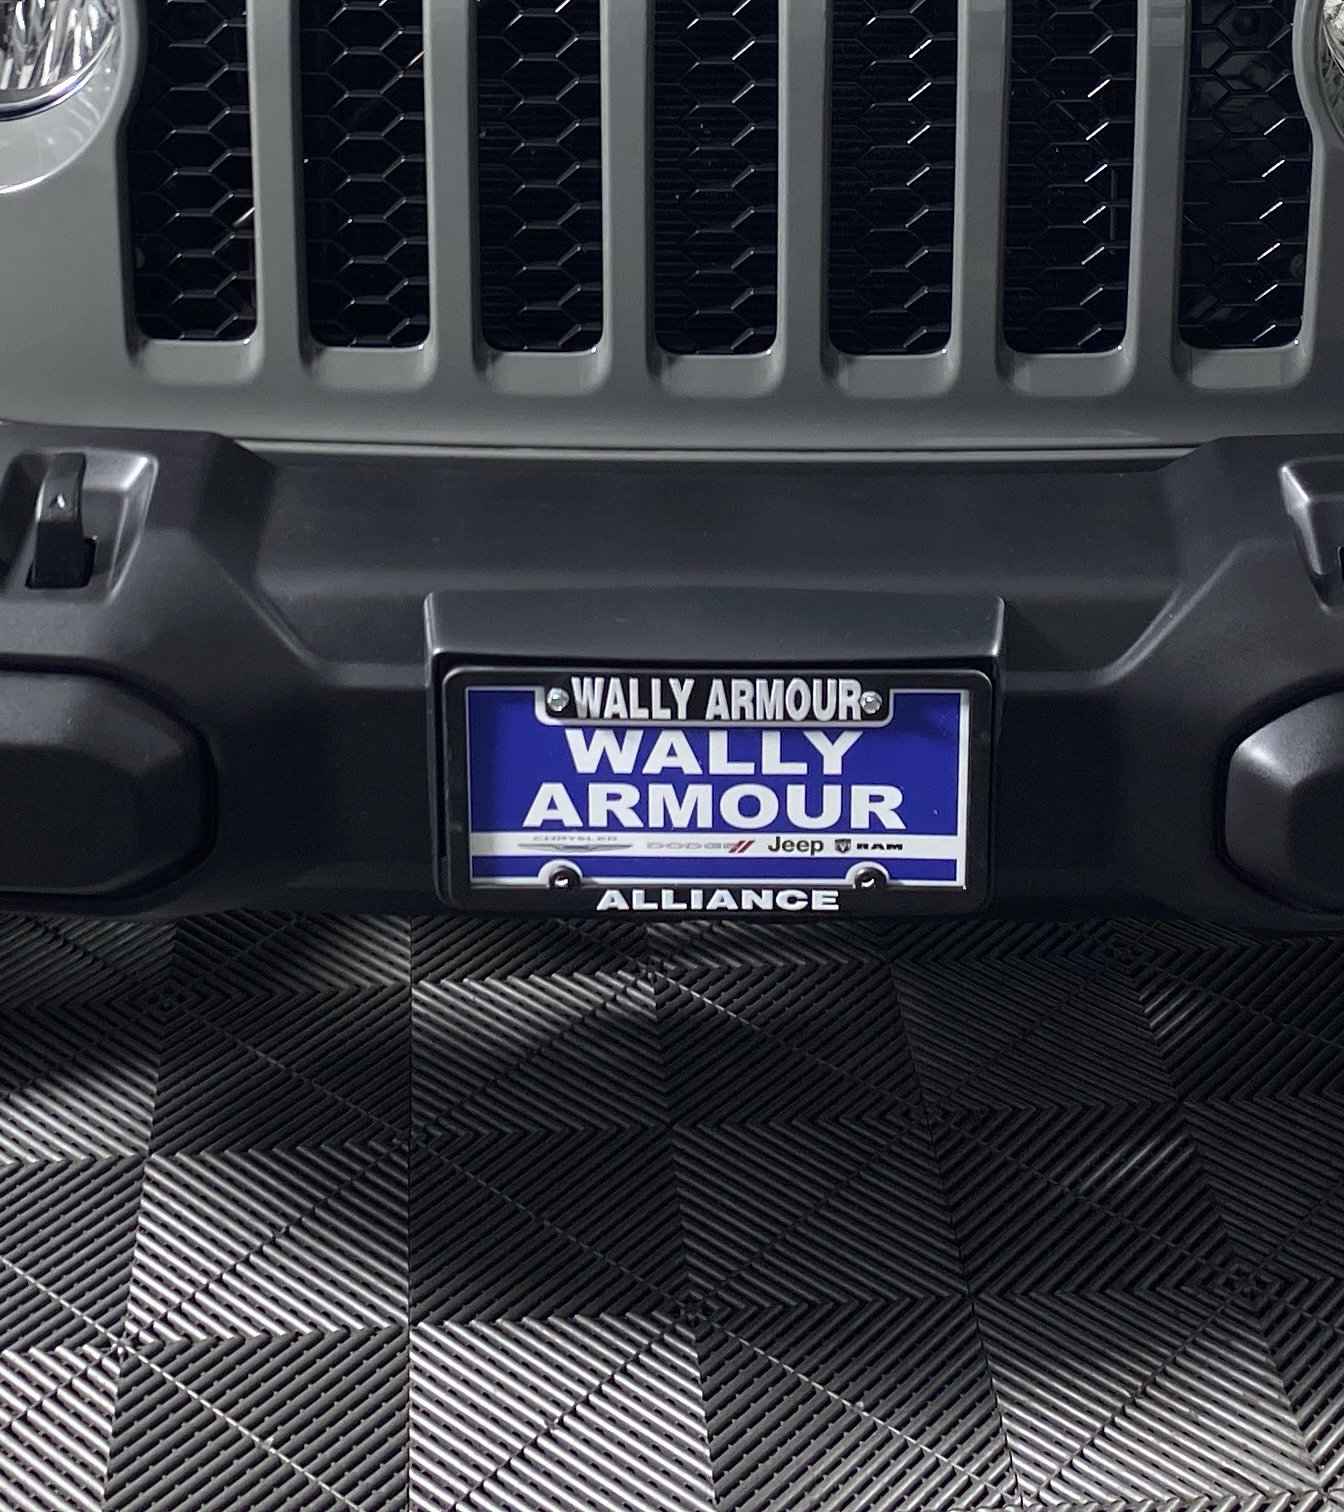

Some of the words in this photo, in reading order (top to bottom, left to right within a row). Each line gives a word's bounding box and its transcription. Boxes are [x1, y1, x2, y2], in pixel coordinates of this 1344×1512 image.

[571, 677, 695, 720] WALLY
[705, 678, 862, 721] ARMOUR
[564, 729, 863, 775] WALLY
[522, 782, 906, 829] ARMOUR
[768, 836, 824, 855] Jeep
[596, 890, 839, 911] ALLIANCE
